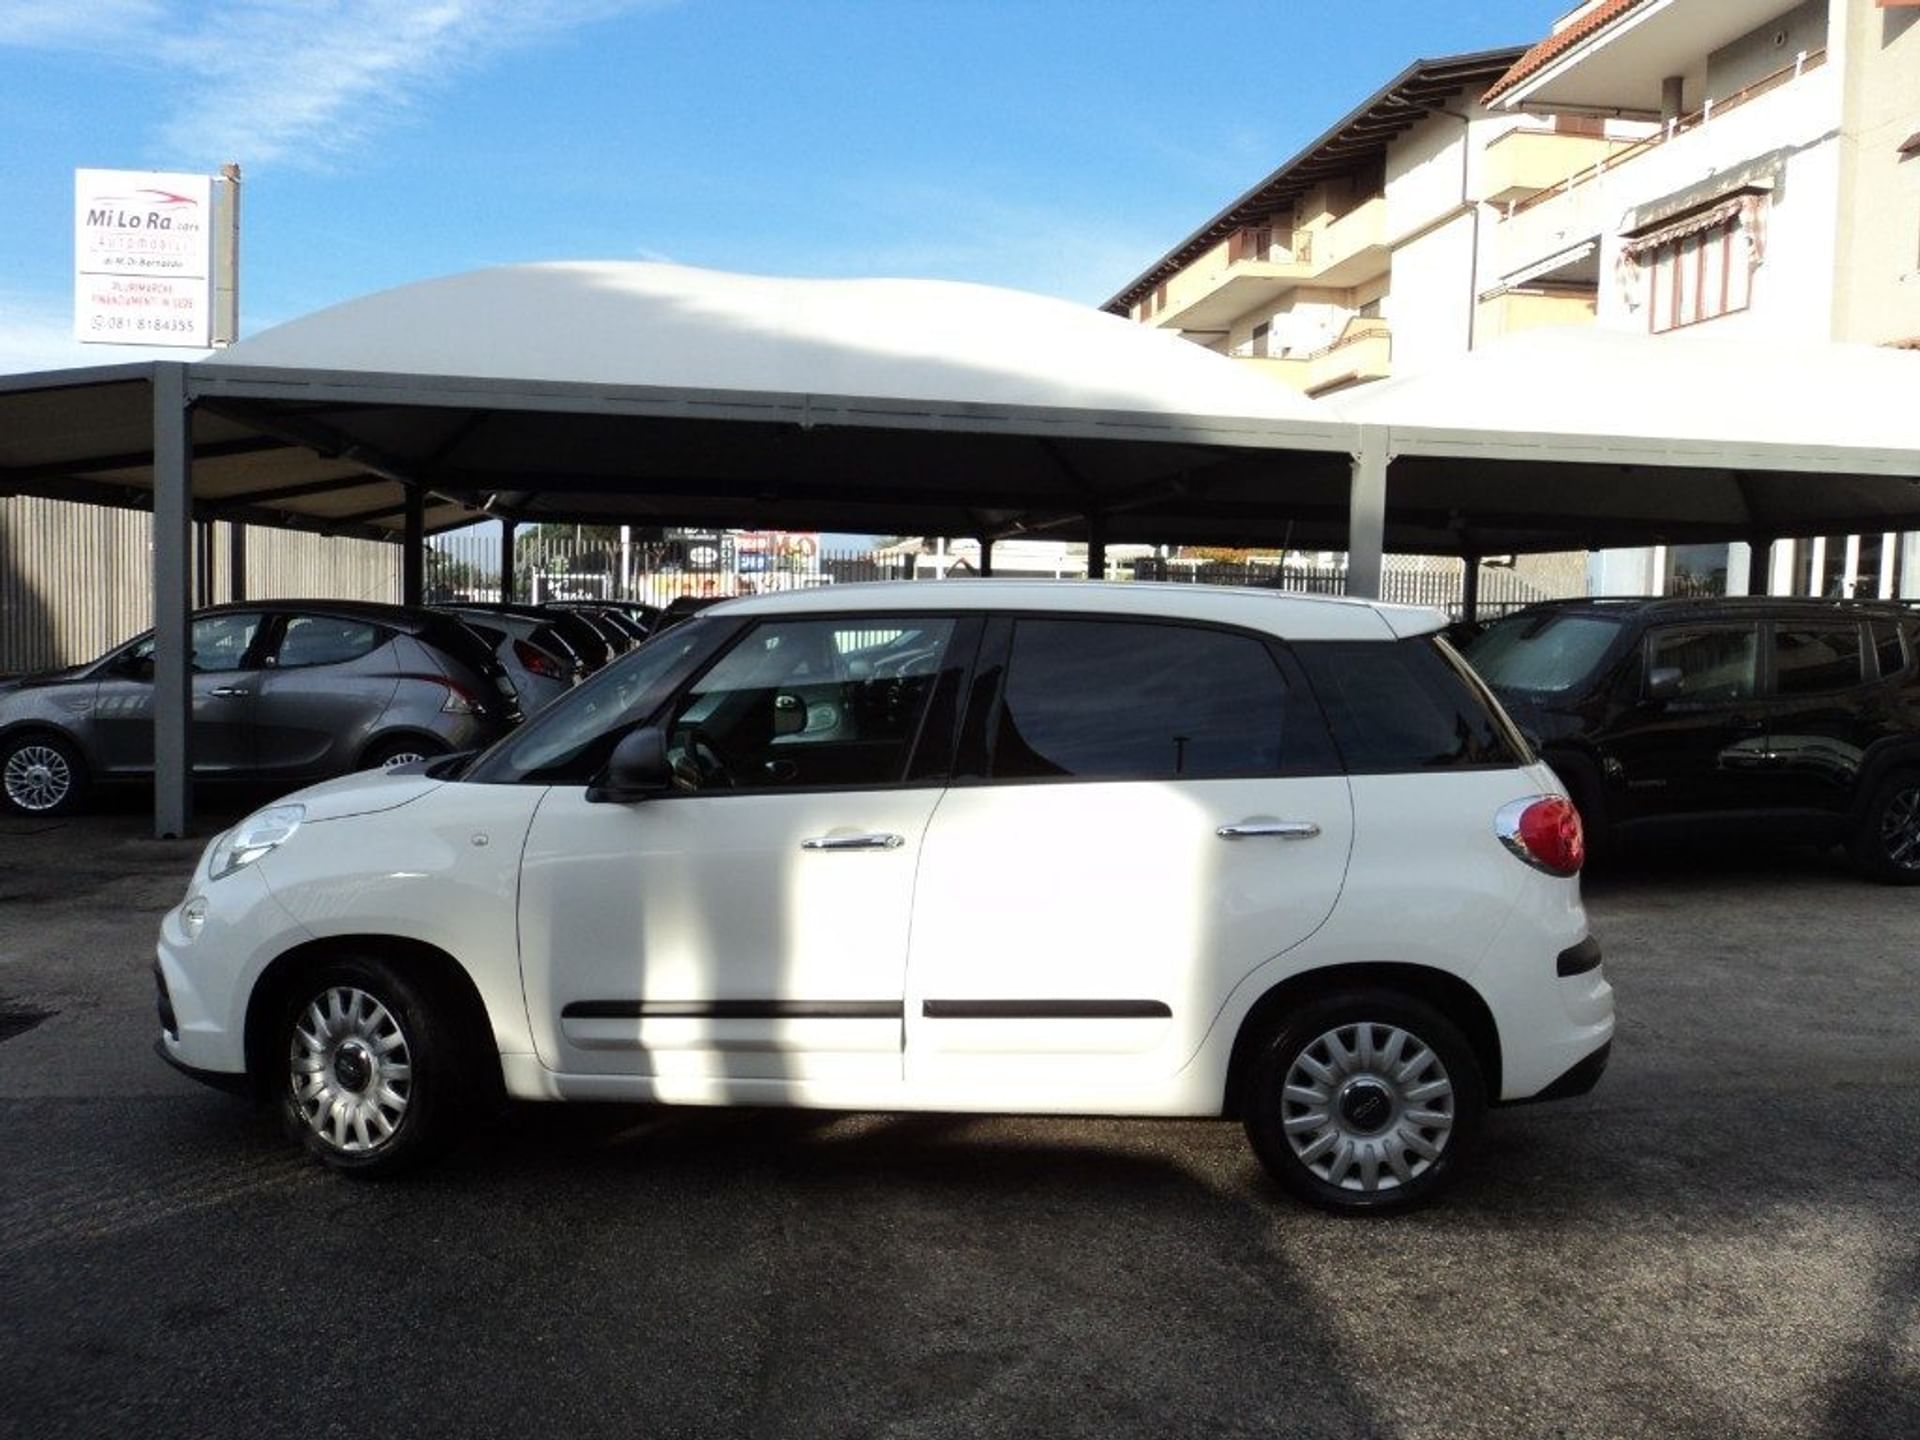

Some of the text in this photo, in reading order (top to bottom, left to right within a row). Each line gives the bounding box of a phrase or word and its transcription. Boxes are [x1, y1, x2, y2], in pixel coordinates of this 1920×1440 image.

[86, 208, 115, 227] Mi
[117, 210, 142, 229] Lo
[145, 211, 173, 231] Ra
[109, 316, 132, 330] 081
